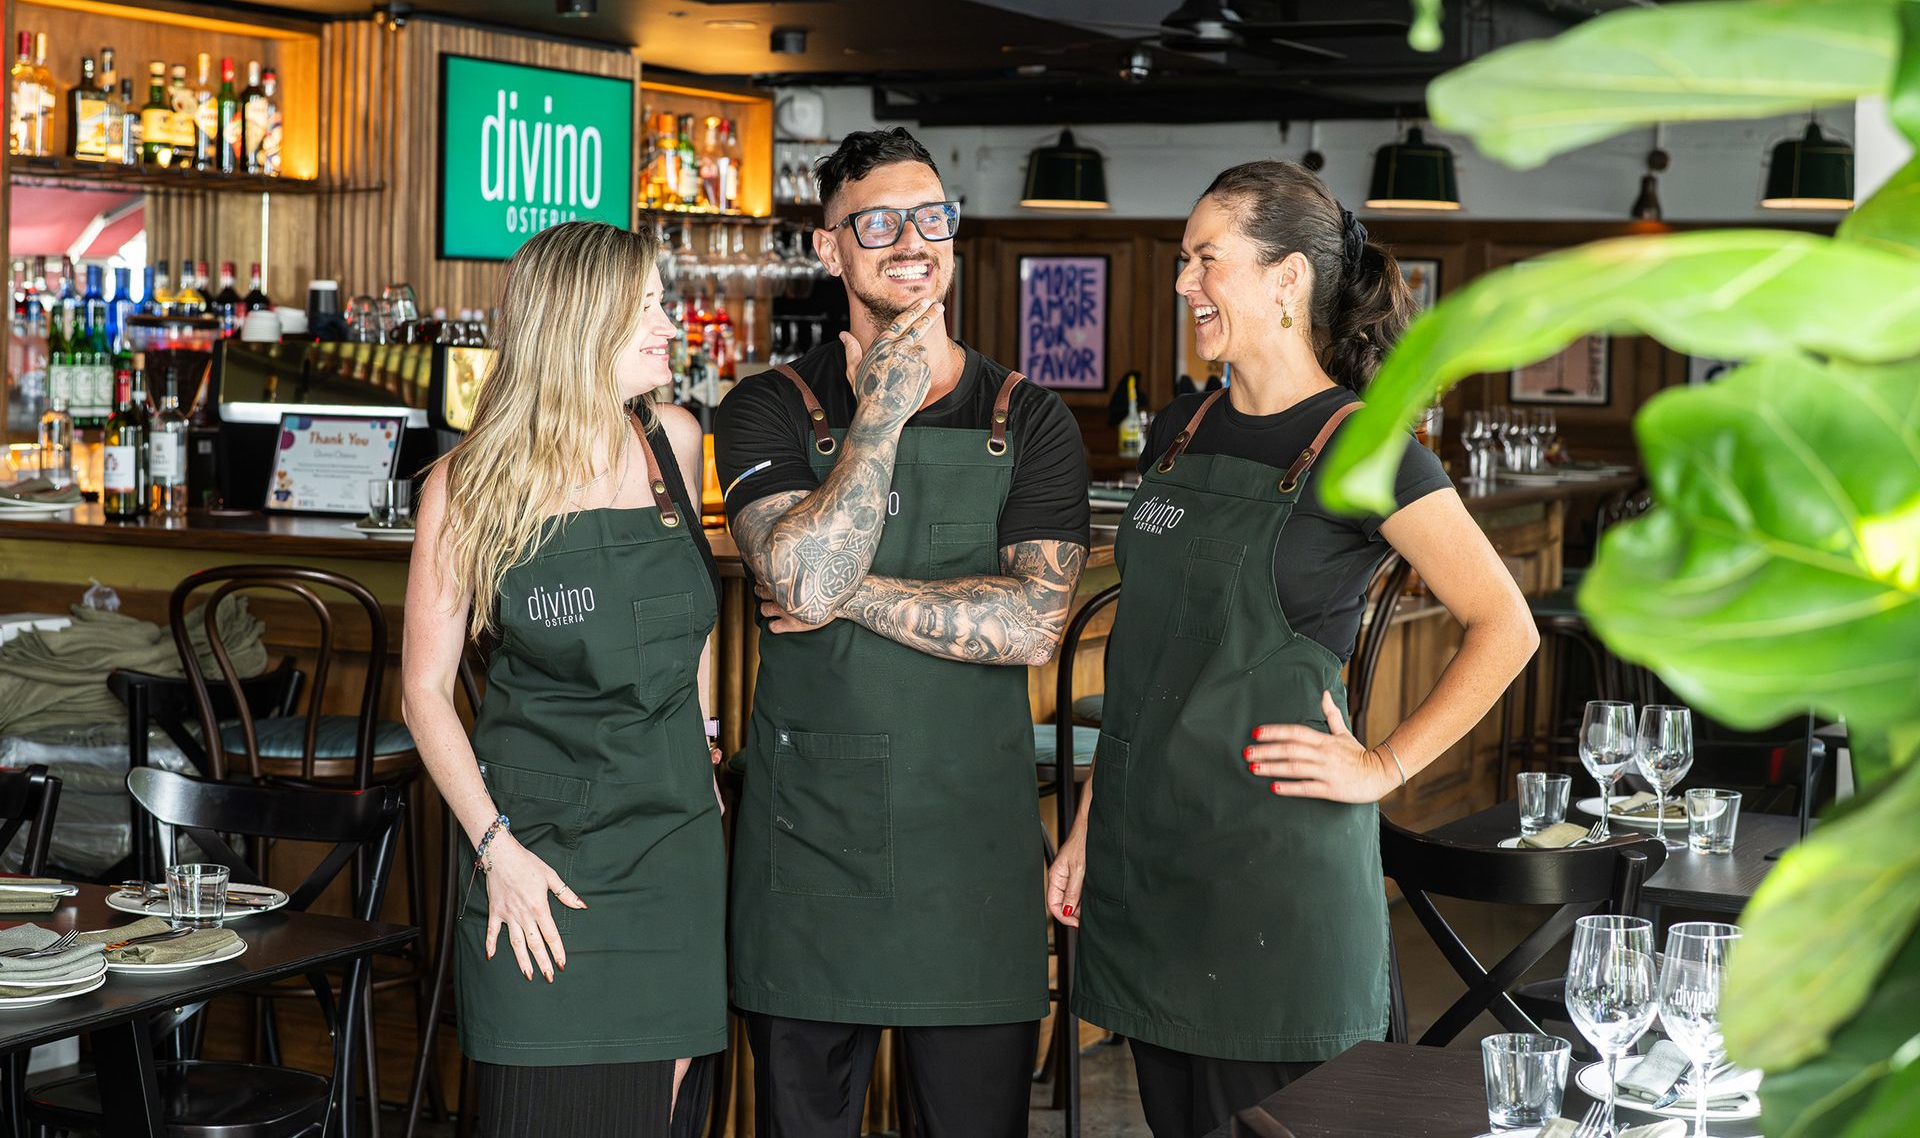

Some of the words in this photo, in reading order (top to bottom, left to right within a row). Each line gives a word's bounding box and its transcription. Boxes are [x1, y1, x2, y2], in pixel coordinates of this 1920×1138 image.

[480, 89, 602, 209] divino
[1029, 264, 1097, 296] MORE
[1028, 297, 1098, 328] AMOR
[1030, 323, 1071, 353] POR
[1027, 347, 1098, 382] FAVOR
[309, 431, 344, 446] Thank
[348, 433, 369, 447] You
[1133, 496, 1185, 529] divino
[1135, 521, 1163, 535] OSTERIA
[527, 583, 595, 621] divino
[545, 613, 585, 628] OSTERIA
